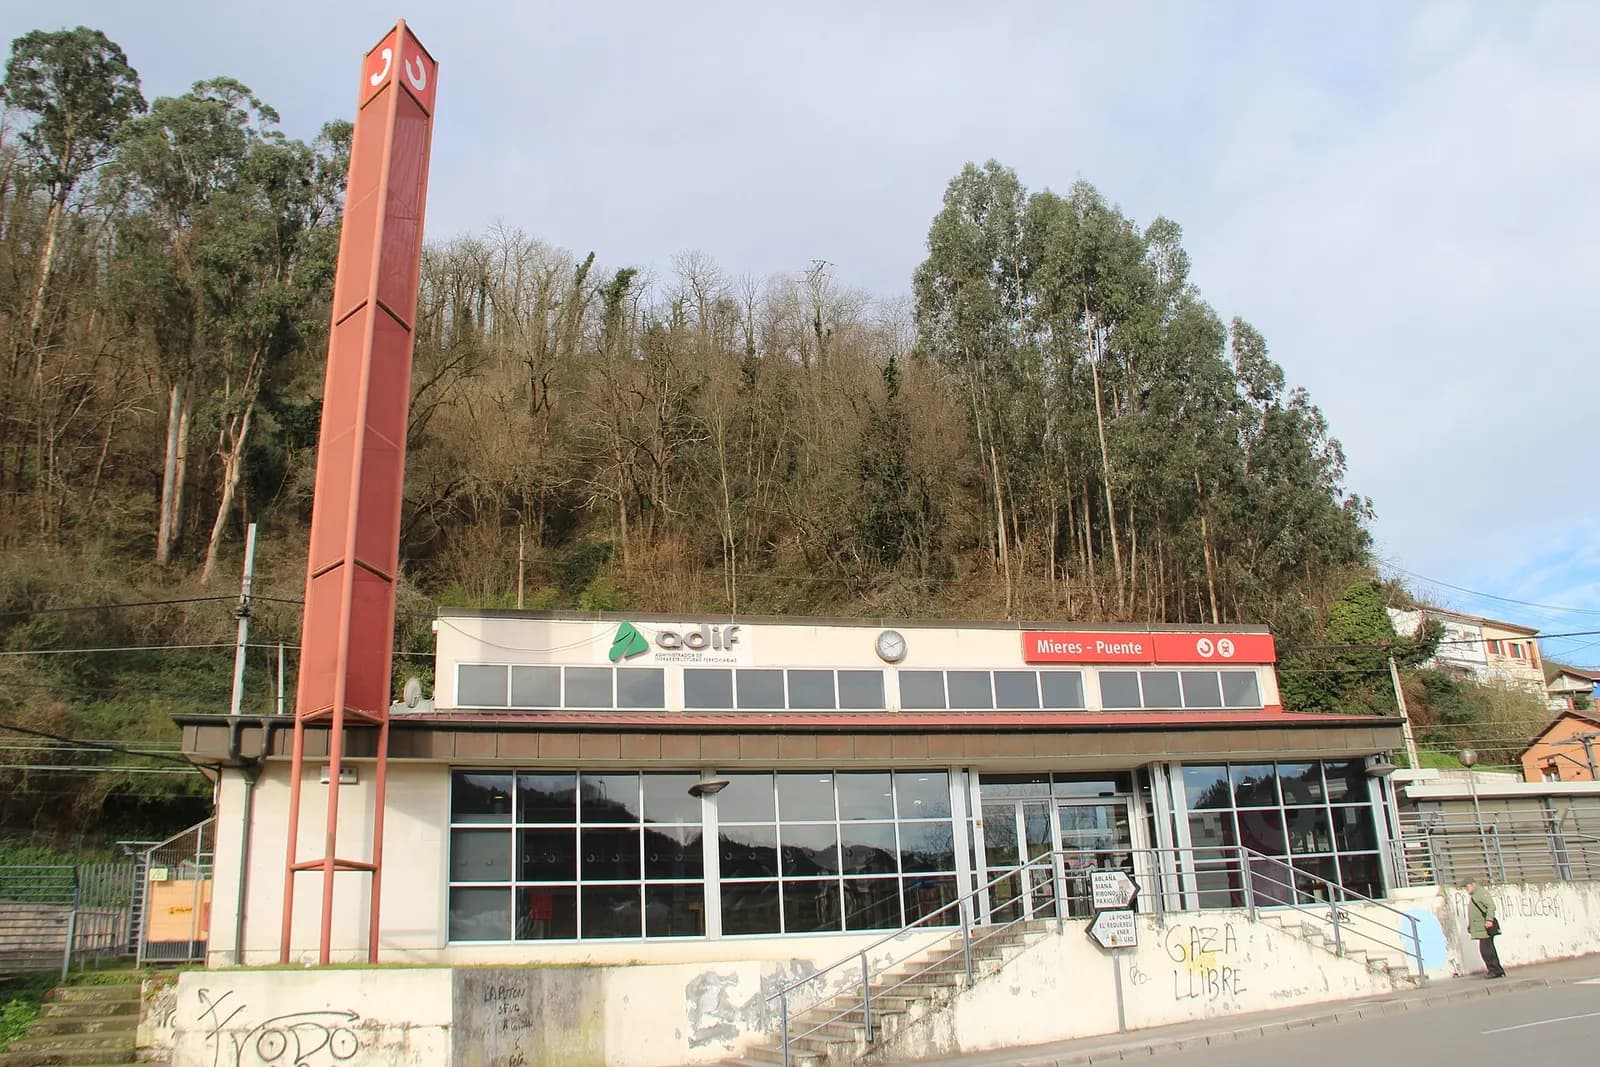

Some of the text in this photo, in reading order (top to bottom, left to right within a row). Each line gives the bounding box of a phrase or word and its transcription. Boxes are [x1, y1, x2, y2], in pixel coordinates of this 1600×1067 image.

[655, 624, 740, 651] adif
[1037, 639, 1083, 654] Mieres
[1096, 640, 1143, 655] Puente
[1165, 922, 1237, 964] GAZA
